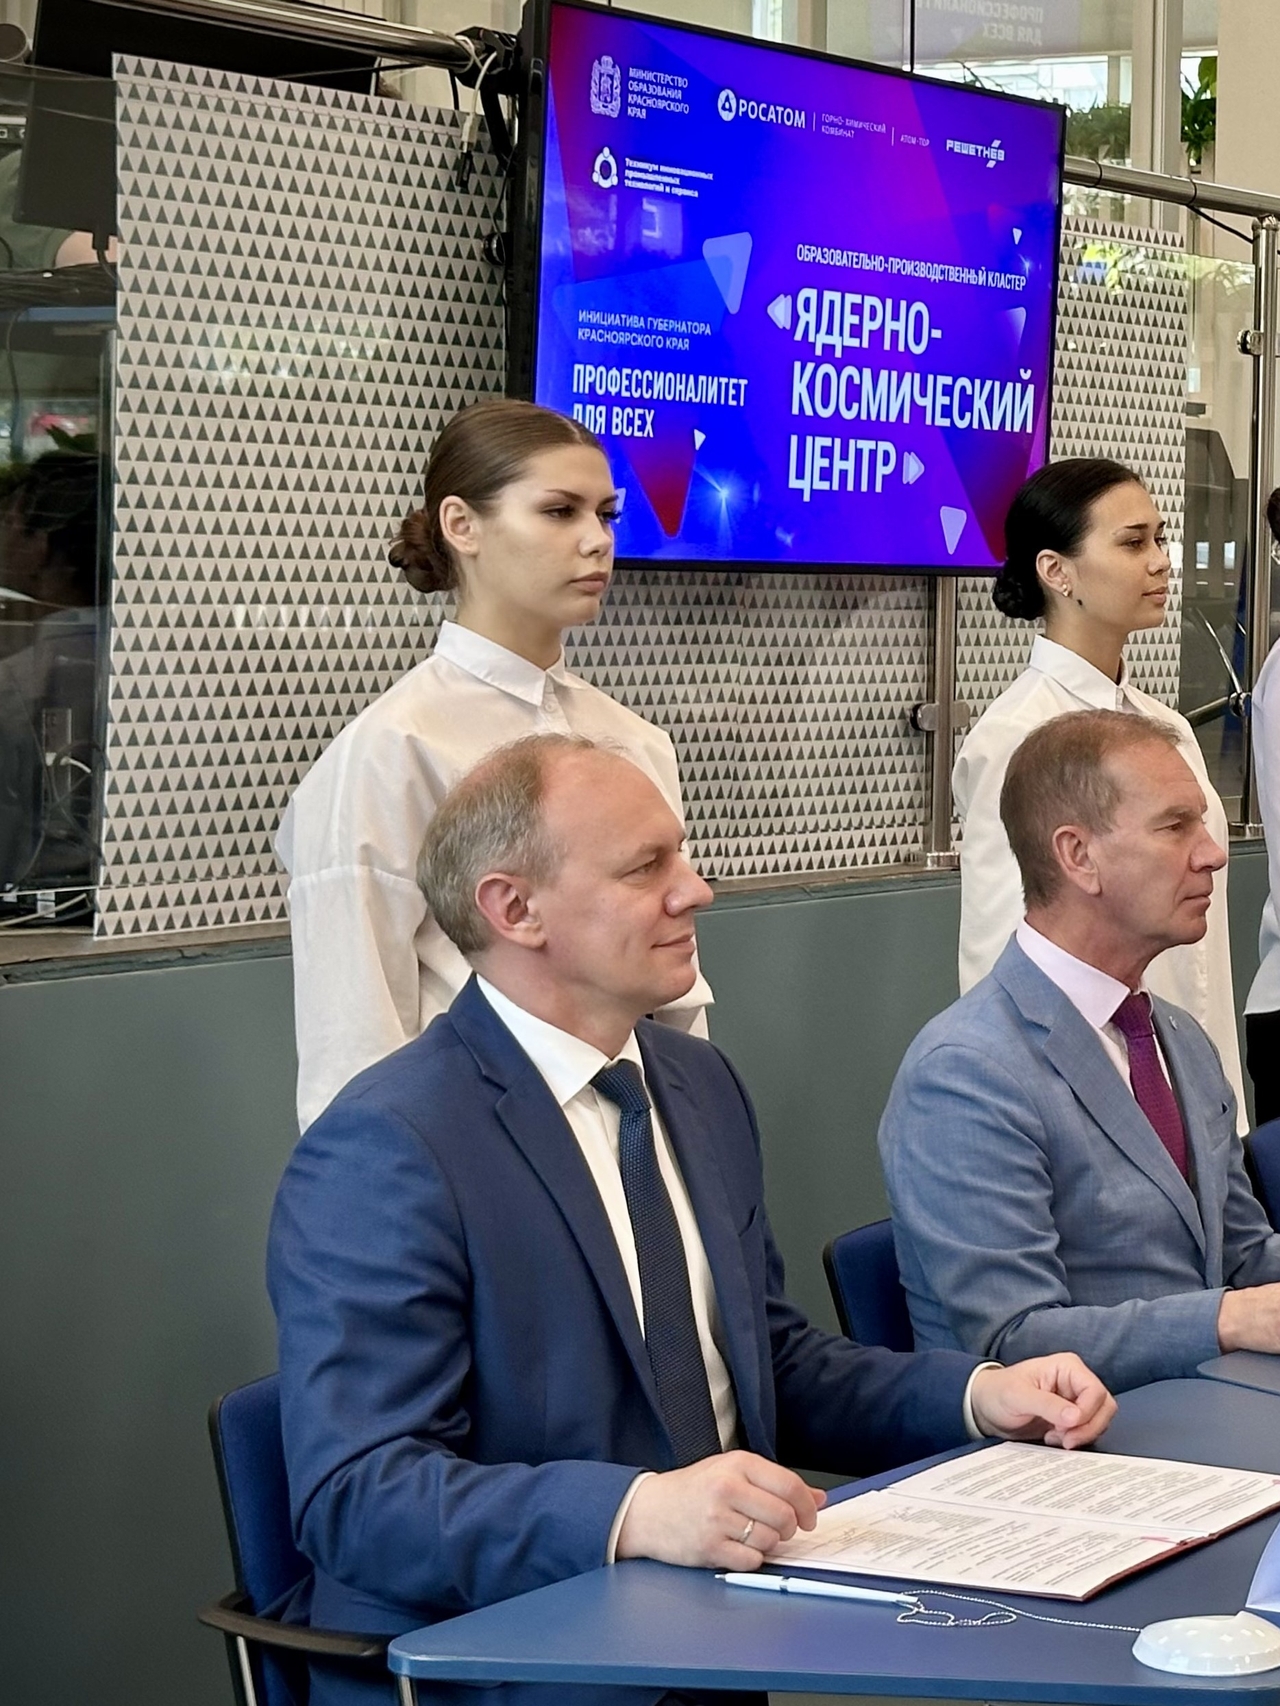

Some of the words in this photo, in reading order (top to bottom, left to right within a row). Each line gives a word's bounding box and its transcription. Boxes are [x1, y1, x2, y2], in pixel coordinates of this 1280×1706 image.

[628, 67, 688, 88] МИНИСТЕРСТВО
[628, 80, 682, 100] ОБРАЗОВАНИЯ
[627, 93, 689, 114] КРАСНОЯРСКОГО
[627, 106, 646, 119] КРАЯ
[739, 98, 806, 129] РОСАТОМ
[821, 125, 855, 139] КОМБИНАТ
[625, 158, 659, 172] Техникум
[796, 243, 986, 285] ОБРАЗОВАТЕЛЬНО-ПРОИЗВОДСТВЕННЫЙ
[987, 271, 1027, 291] КЛАСТЕР
[578, 309, 645, 329] ИНИЦИАТИВА
[647, 317, 712, 335] ГУБЕРНАТОРА
[794, 287, 942, 358] ЯДЕРНО-
[577, 328, 664, 348] КРАСНОЯРСКОГО
[665, 338, 690, 351] КРАЯ
[572, 363, 749, 407] ПРОФЕССИОНАЛИТЕТ
[791, 361, 1036, 434] КОСМИЧЕСКИЙ
[611, 406, 655, 438] ВСЕХ
[788, 434, 896, 503] ЦЕНТР
